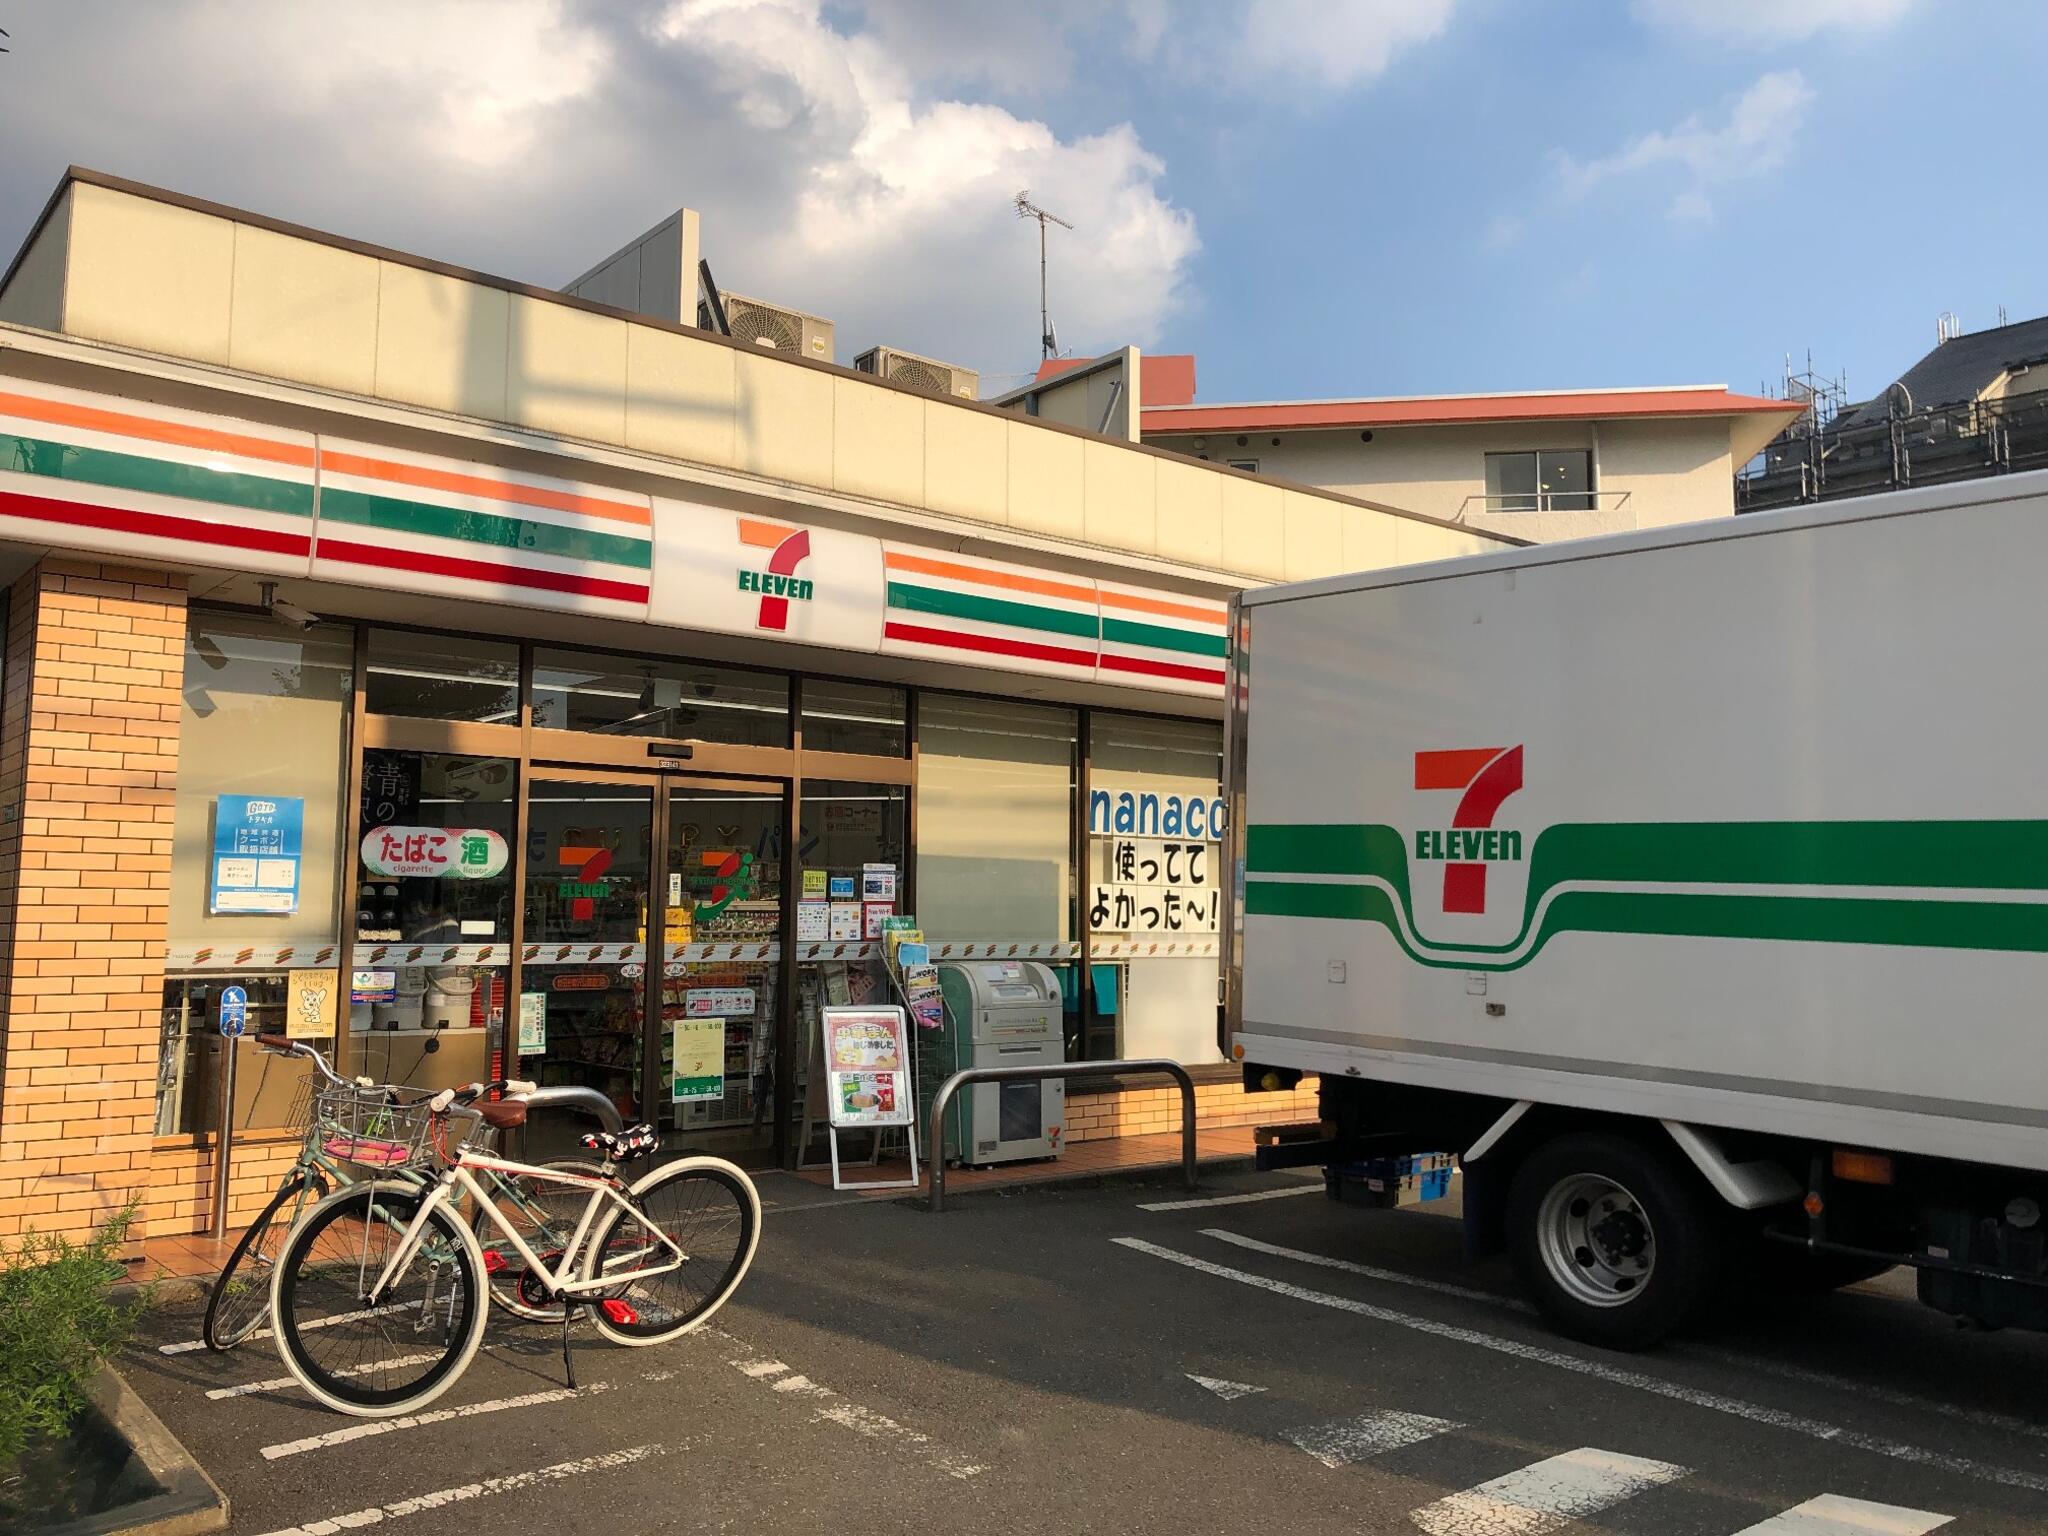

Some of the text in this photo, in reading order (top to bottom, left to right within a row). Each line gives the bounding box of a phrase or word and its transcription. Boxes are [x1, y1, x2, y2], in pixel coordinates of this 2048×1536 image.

[737, 518, 811, 631] 7
[1414, 743, 1524, 914] 7
[380, 833, 447, 863] たばこ
[460, 836, 490, 865] 酒
[392, 865, 434, 873] cigarette
[463, 865, 488, 875] liquor
[1115, 841, 1206, 884] 使ってて
[916, 968, 937, 978] WORK
[919, 989, 941, 1000] WORK
[837, 1025, 894, 1039] 中華まん
